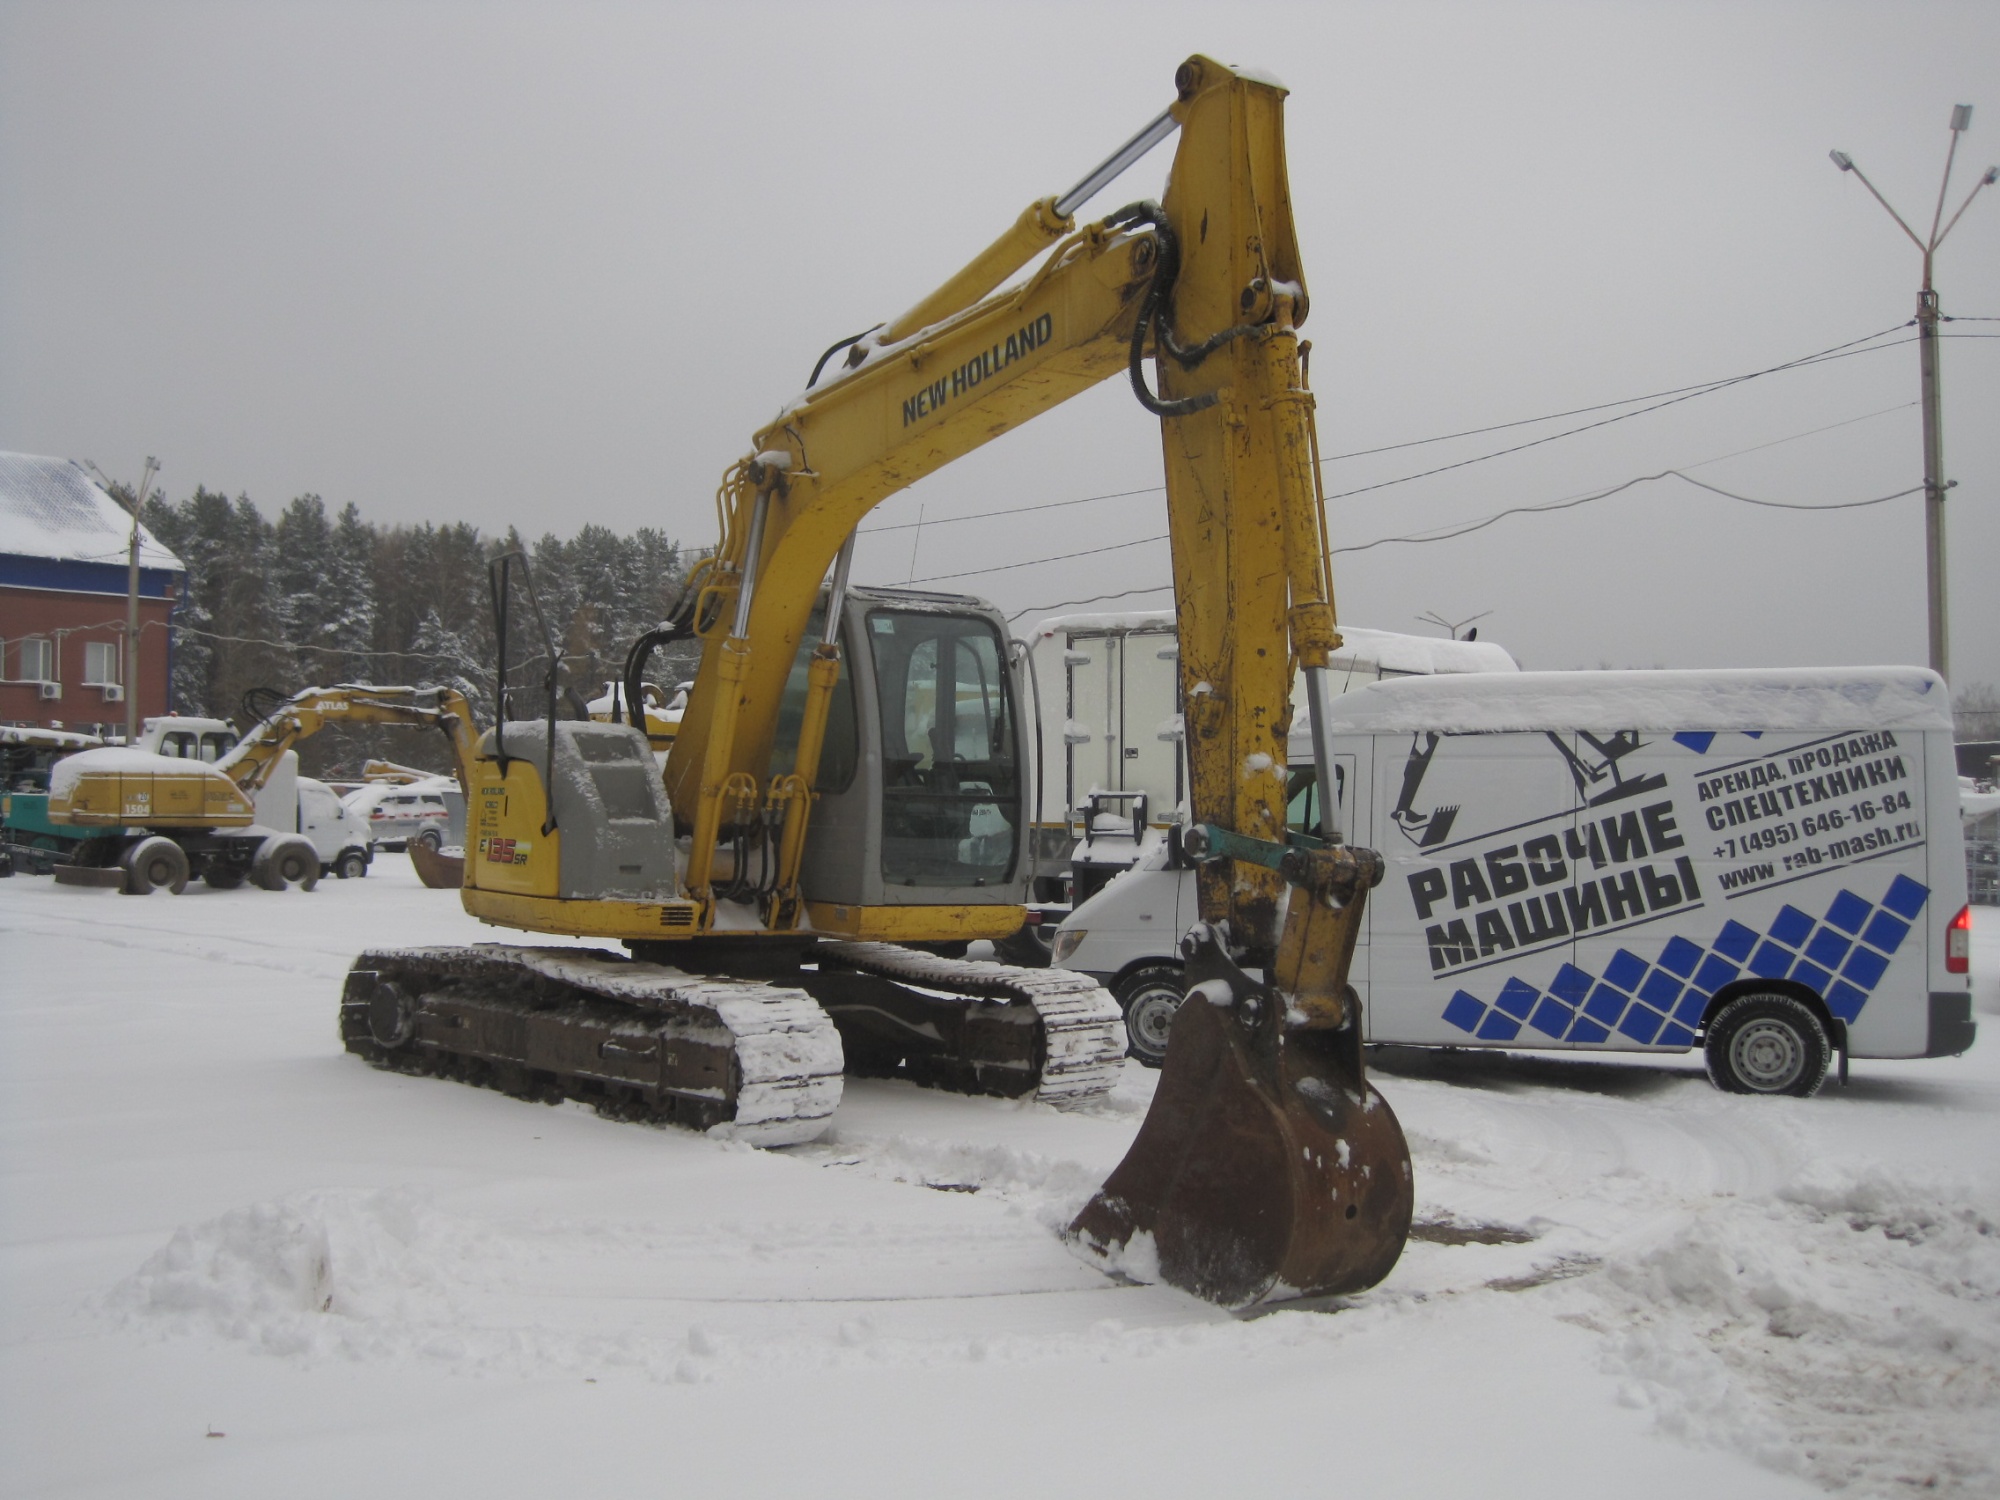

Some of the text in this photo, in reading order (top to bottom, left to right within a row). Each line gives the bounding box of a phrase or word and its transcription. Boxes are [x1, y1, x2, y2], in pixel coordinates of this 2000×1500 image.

[903, 312, 1052, 428] NEW HOLLAND
[315, 700, 349, 711] ATLAS
[1697, 731, 1898, 802] АРЕНДА, ПРОДАЖА
[1705, 755, 1906, 831] СПЕЦТЕХНИКИ
[125, 804, 150, 815] 1504
[1713, 791, 1911, 858] +7 (495) 646-16-84
[1407, 800, 1685, 920] РАБОЧИЕ
[1425, 855, 1702, 971] МАШИНЫ
